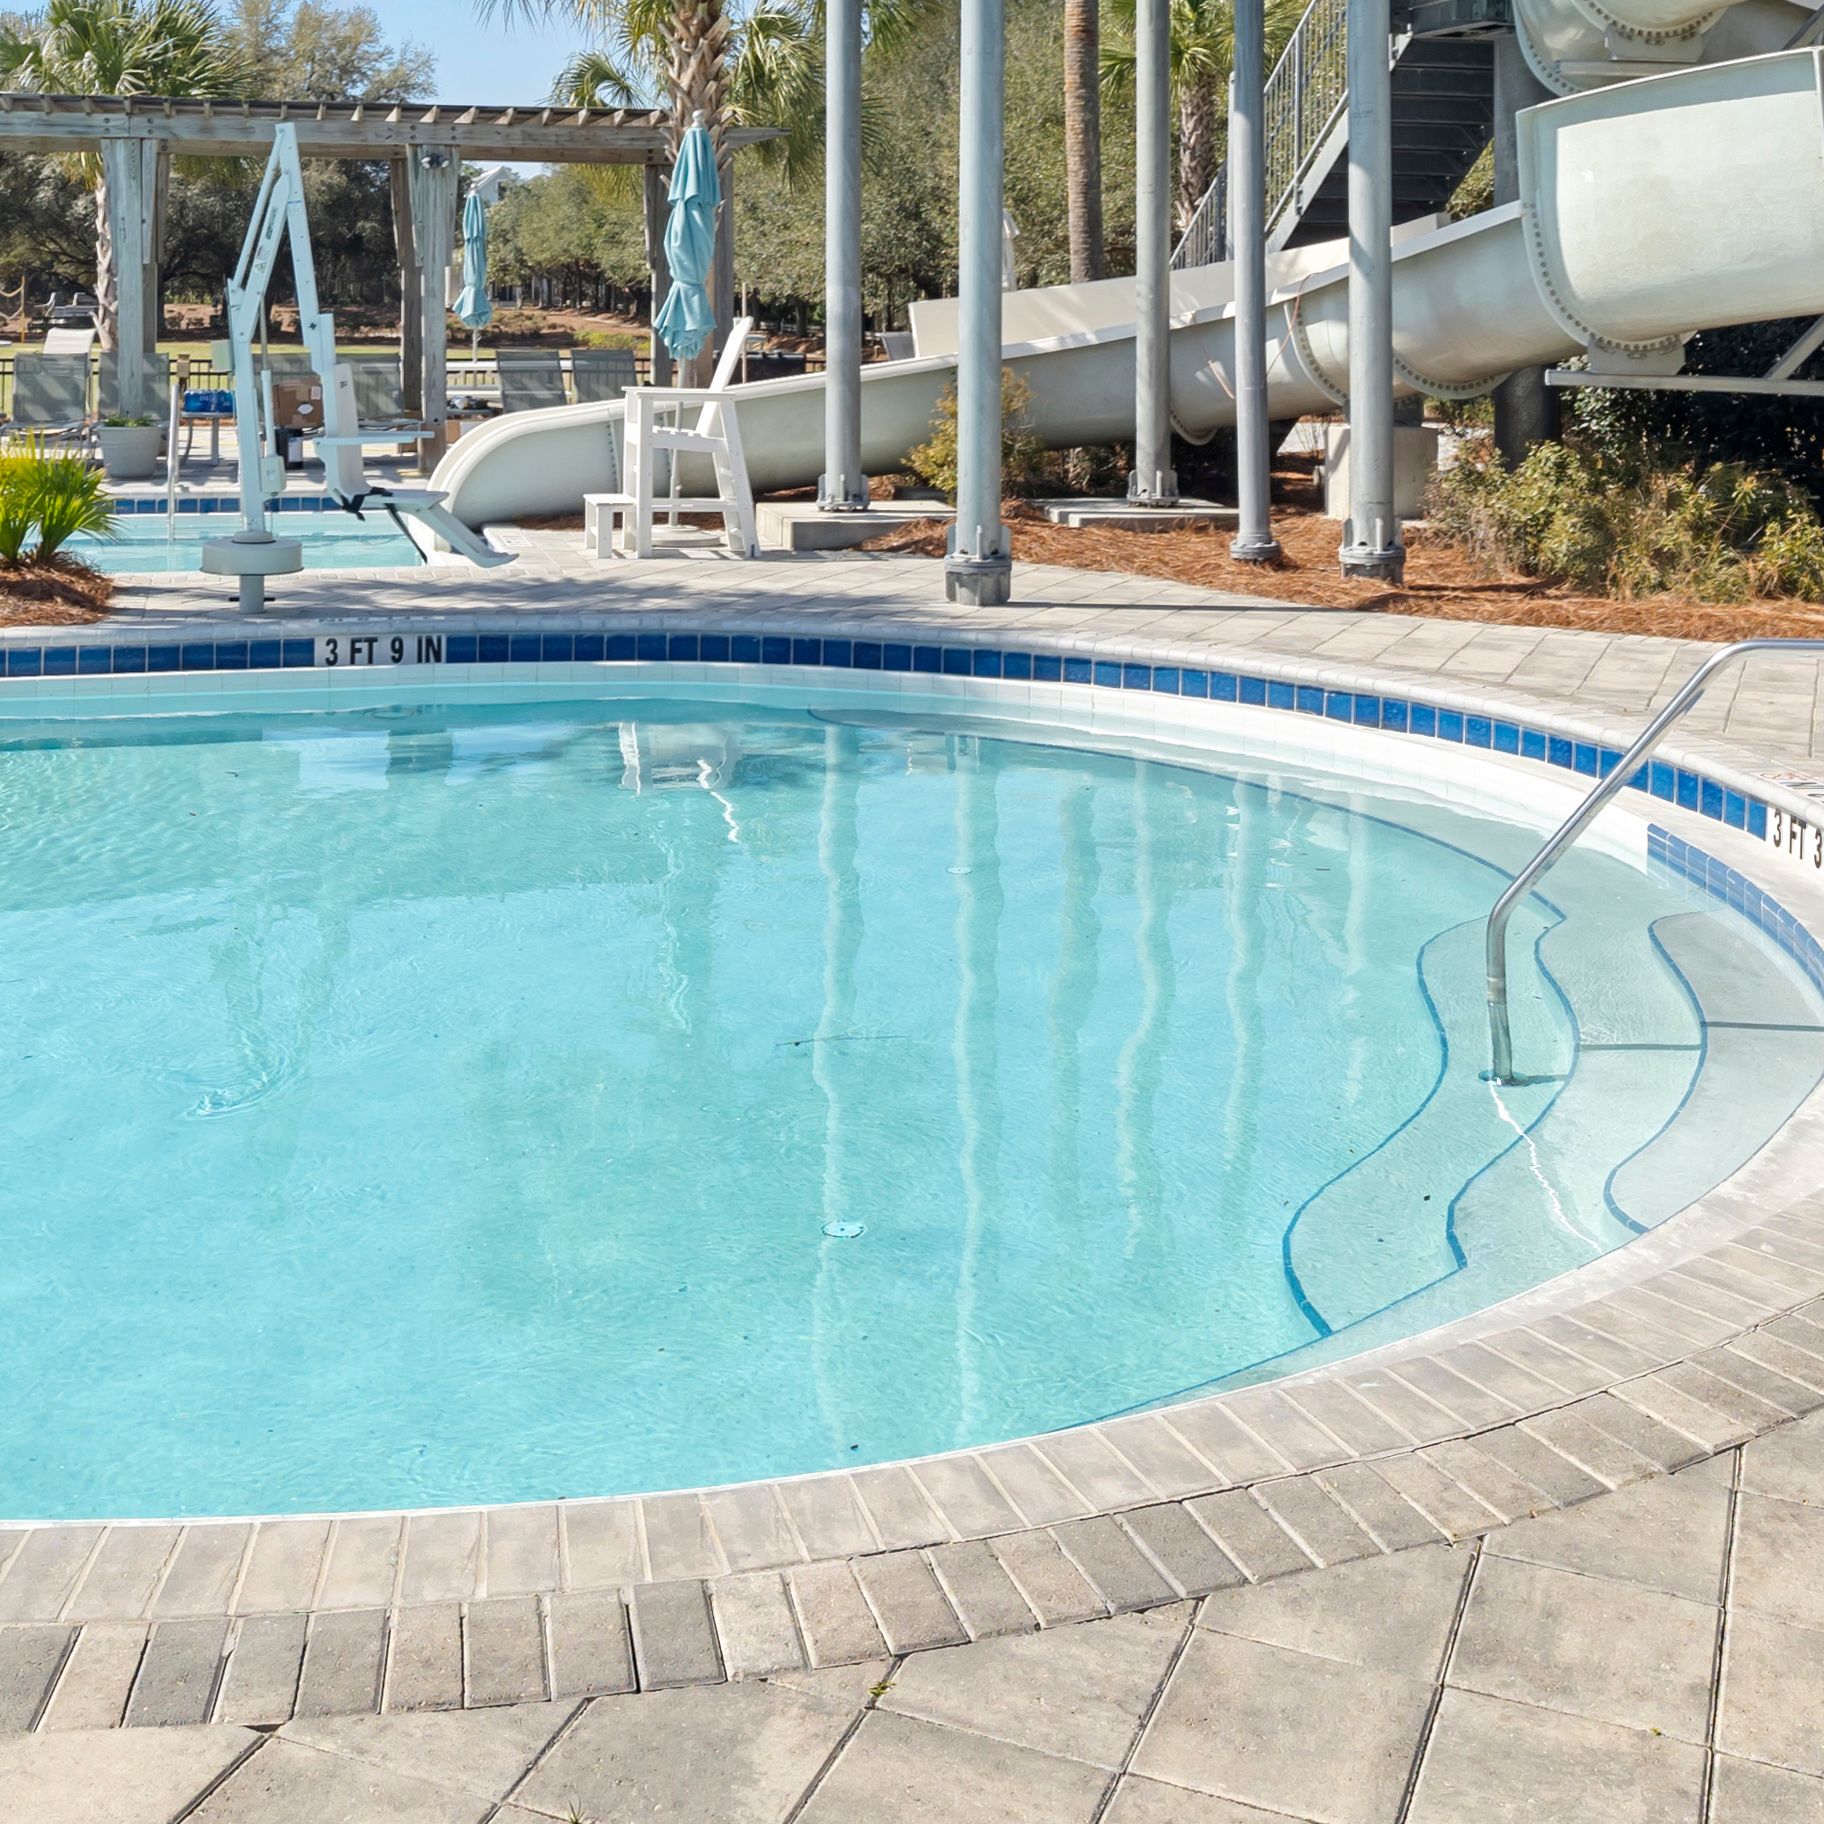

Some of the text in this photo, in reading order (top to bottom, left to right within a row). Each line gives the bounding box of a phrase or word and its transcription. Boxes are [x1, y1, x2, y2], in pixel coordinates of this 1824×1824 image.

[325, 634, 443, 667] 3 FT 9 IN
[1773, 807, 1782, 848] 3
[1789, 813, 1807, 860] FT
[1814, 827, 1823, 869] 3
